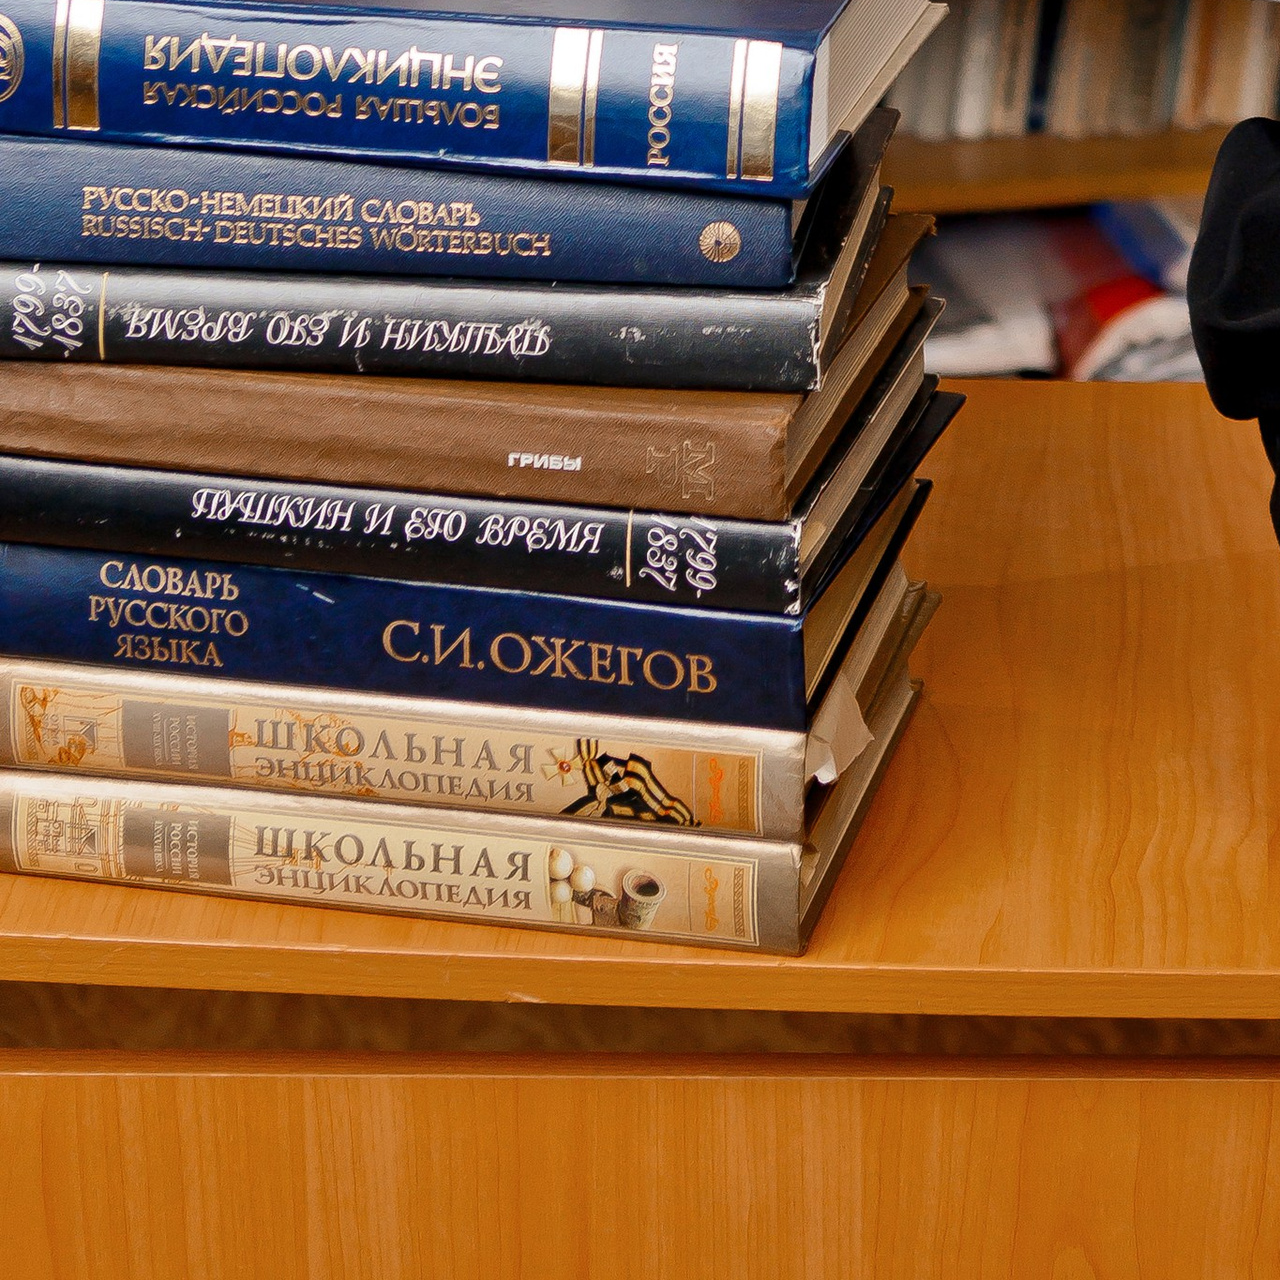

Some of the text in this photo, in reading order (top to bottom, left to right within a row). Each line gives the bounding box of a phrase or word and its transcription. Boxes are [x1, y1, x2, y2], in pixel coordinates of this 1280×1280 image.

[143, 33, 504, 93] ЭНЦИКЛОПЕДИЯ
[143, 80, 500, 129] БОЛЬШАЯ РОССИЙСКАЯ
[647, 41, 680, 167] РОССИЯ
[81, 186, 480, 227] РУССКО-НЕМЕЦКИЙ СЛОВАРЬ
[81, 214, 552, 257] RUSSISCH-DEUTSCHES WÖRTERBUCH
[124, 307, 552, 356] ПУШКИН И ЕГО ВРЕМЯ
[508, 452, 582, 471] ГРИБЫ
[191, 488, 605, 554] ПУШКИН И ЕГО ВРЕМЯ
[99, 560, 240, 601] СЛОВАРЬ
[88, 595, 249, 637] РУССКОГО
[114, 633, 224, 668] ЯЗЫКА
[170, 716, 183, 767] РОССИИ
[186, 715, 200, 771] ИСТОРИЯ
[254, 718, 537, 775] ШКОЛЬНАЯ
[254, 756, 535, 803] ЭНЦИКЛОПЕДИЯ
[170, 822, 183, 875] РОССИИ
[186, 819, 200, 879] ИСТОРИЯ
[254, 826, 533, 883] ШКОЛЬНАЯ
[254, 864, 533, 911] ЭНЦИКЛОПЕДИЯ
